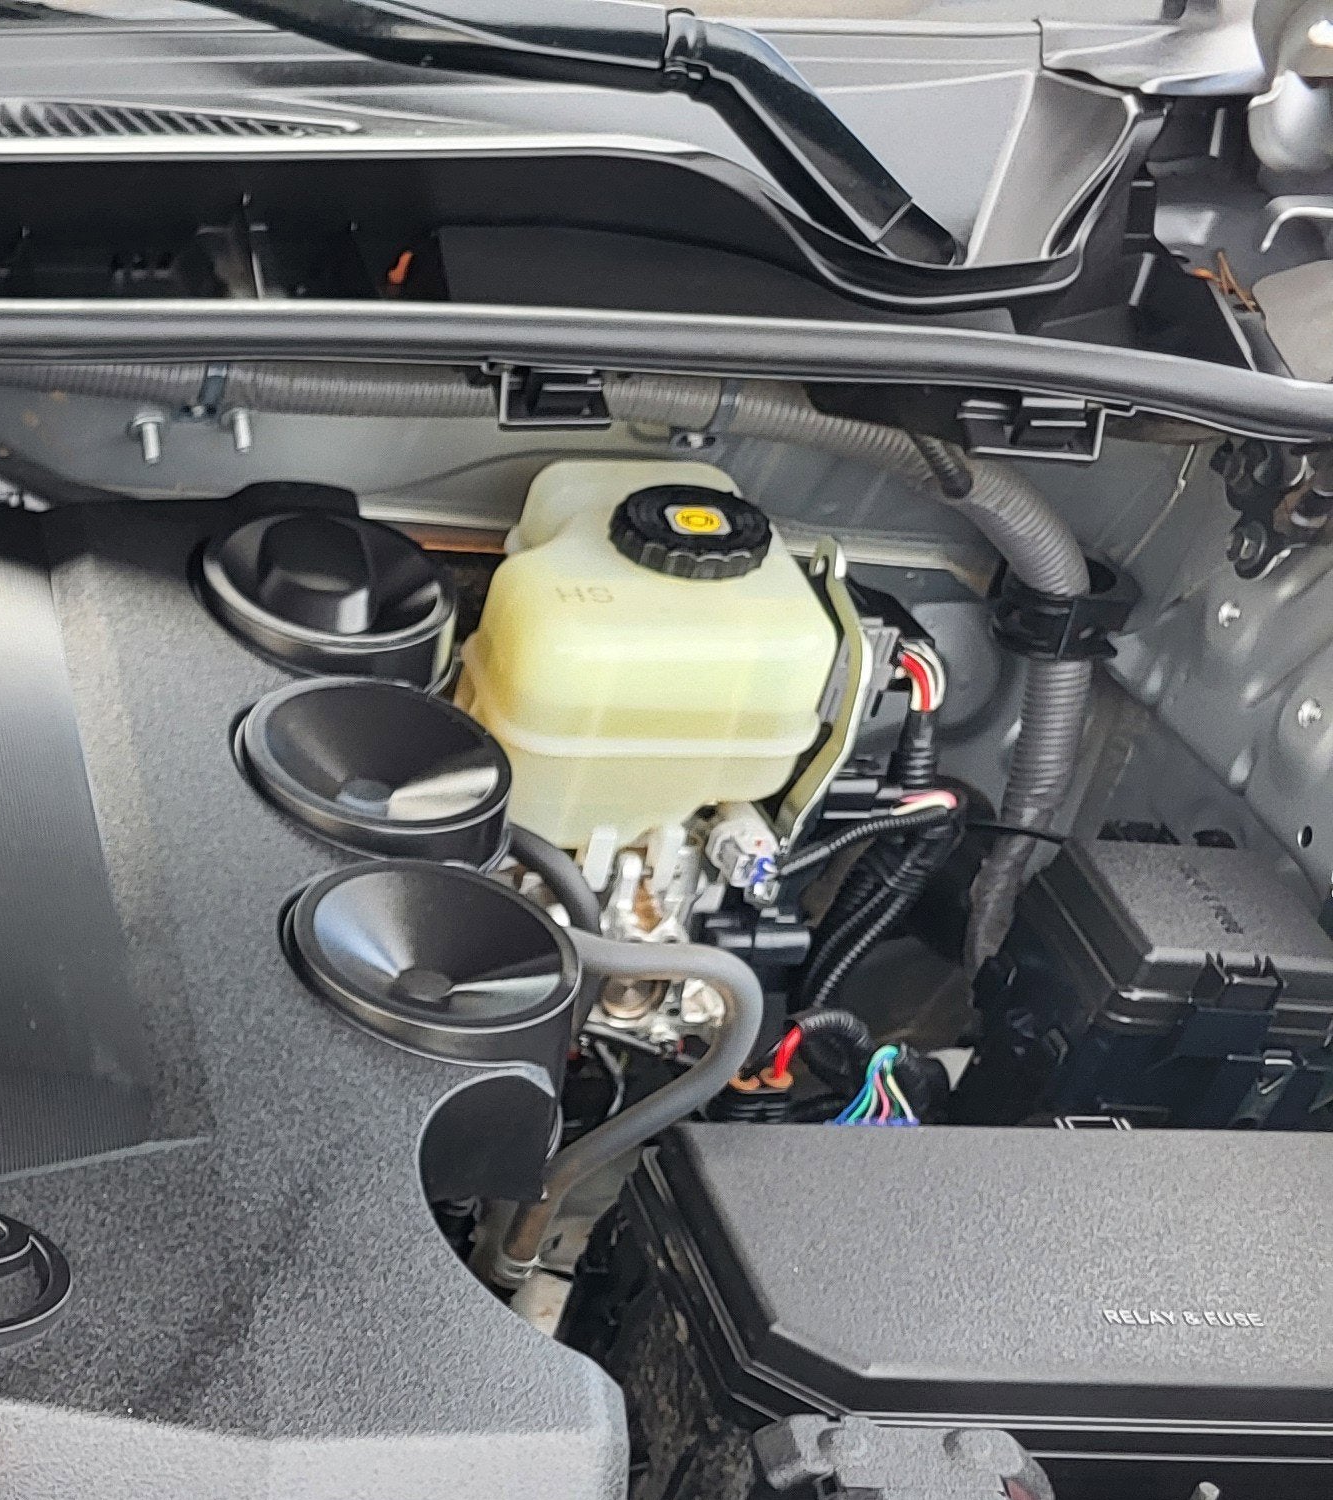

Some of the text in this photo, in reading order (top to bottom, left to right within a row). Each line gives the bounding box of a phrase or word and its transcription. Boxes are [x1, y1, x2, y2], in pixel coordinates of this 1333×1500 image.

[1102, 1309, 1266, 1328] RELAY & FUSE
